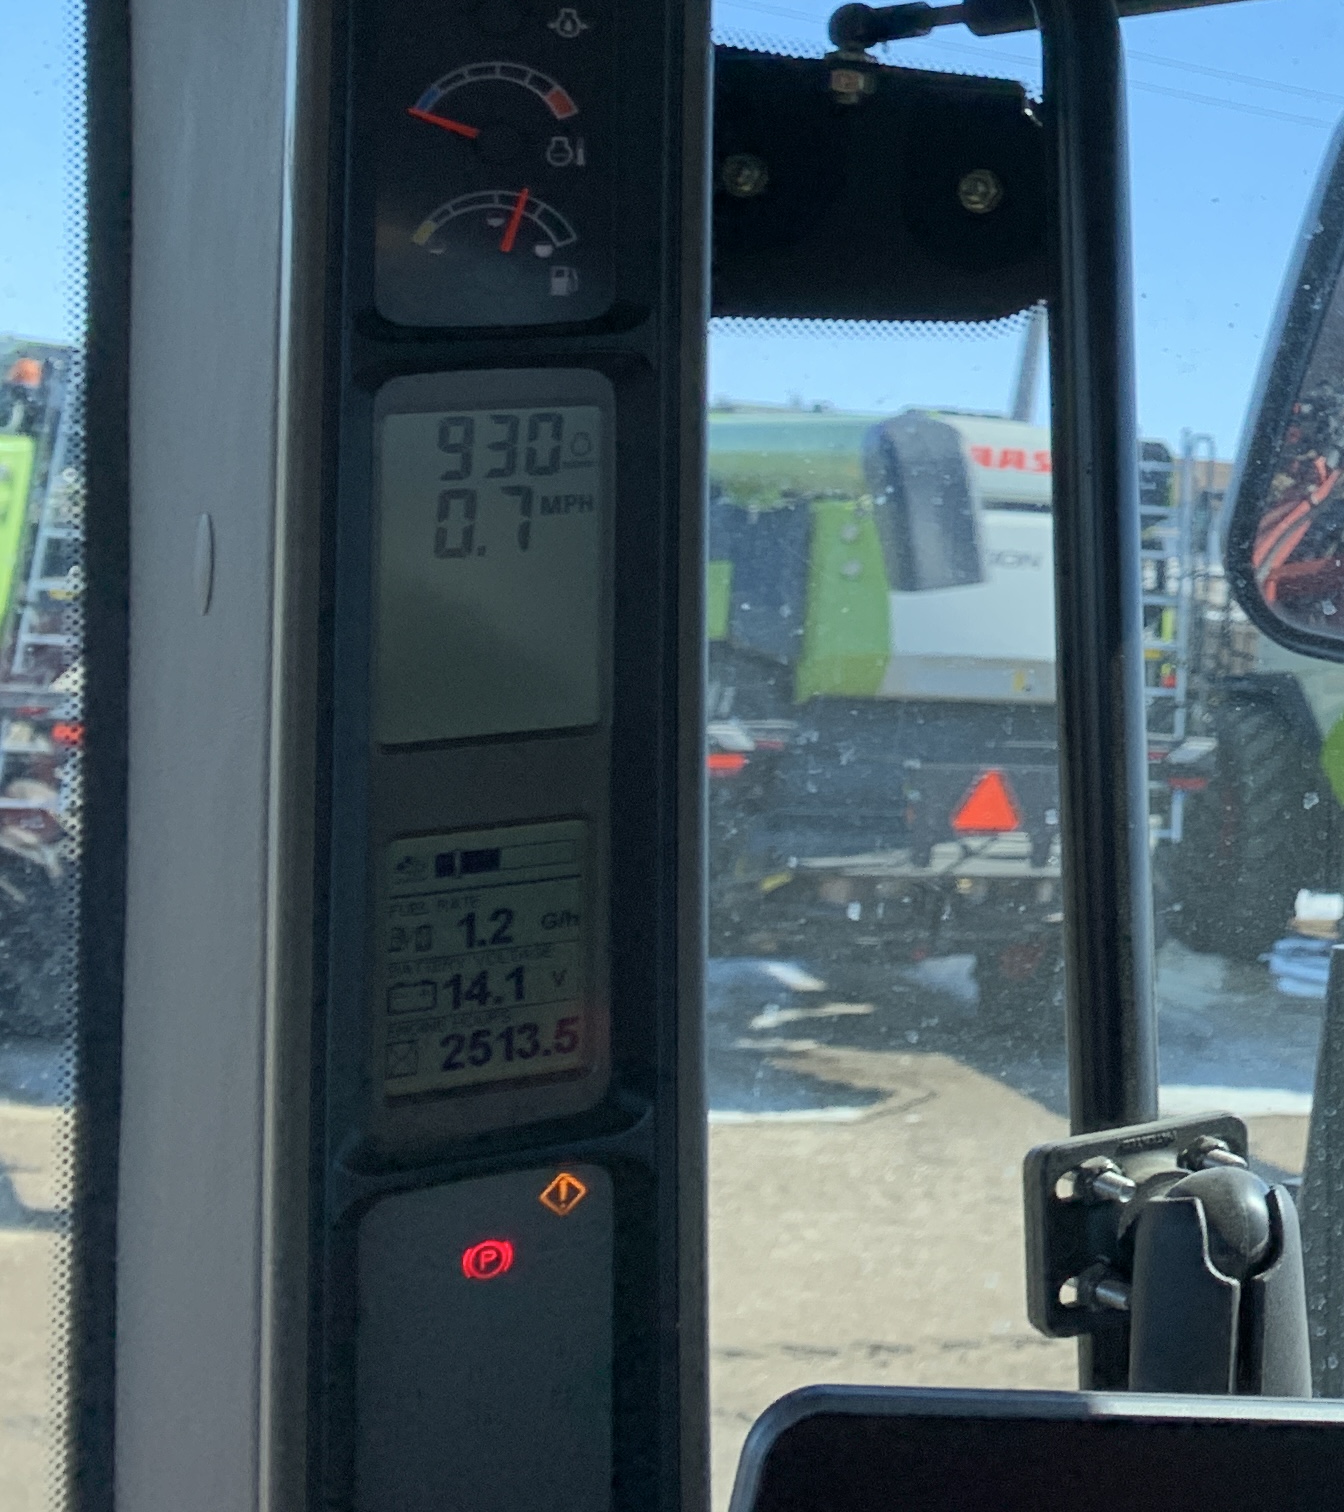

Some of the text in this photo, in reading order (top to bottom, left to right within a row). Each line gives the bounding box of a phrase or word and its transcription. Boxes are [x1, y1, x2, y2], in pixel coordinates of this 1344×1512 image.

[437, 412, 563, 481] 930
[434, 485, 594, 559] 0.7 MPH
[458, 907, 579, 949] 1.2 G/h
[442, 966, 567, 1010] 14.1 V
[440, 1016, 579, 1072] 2513.5
